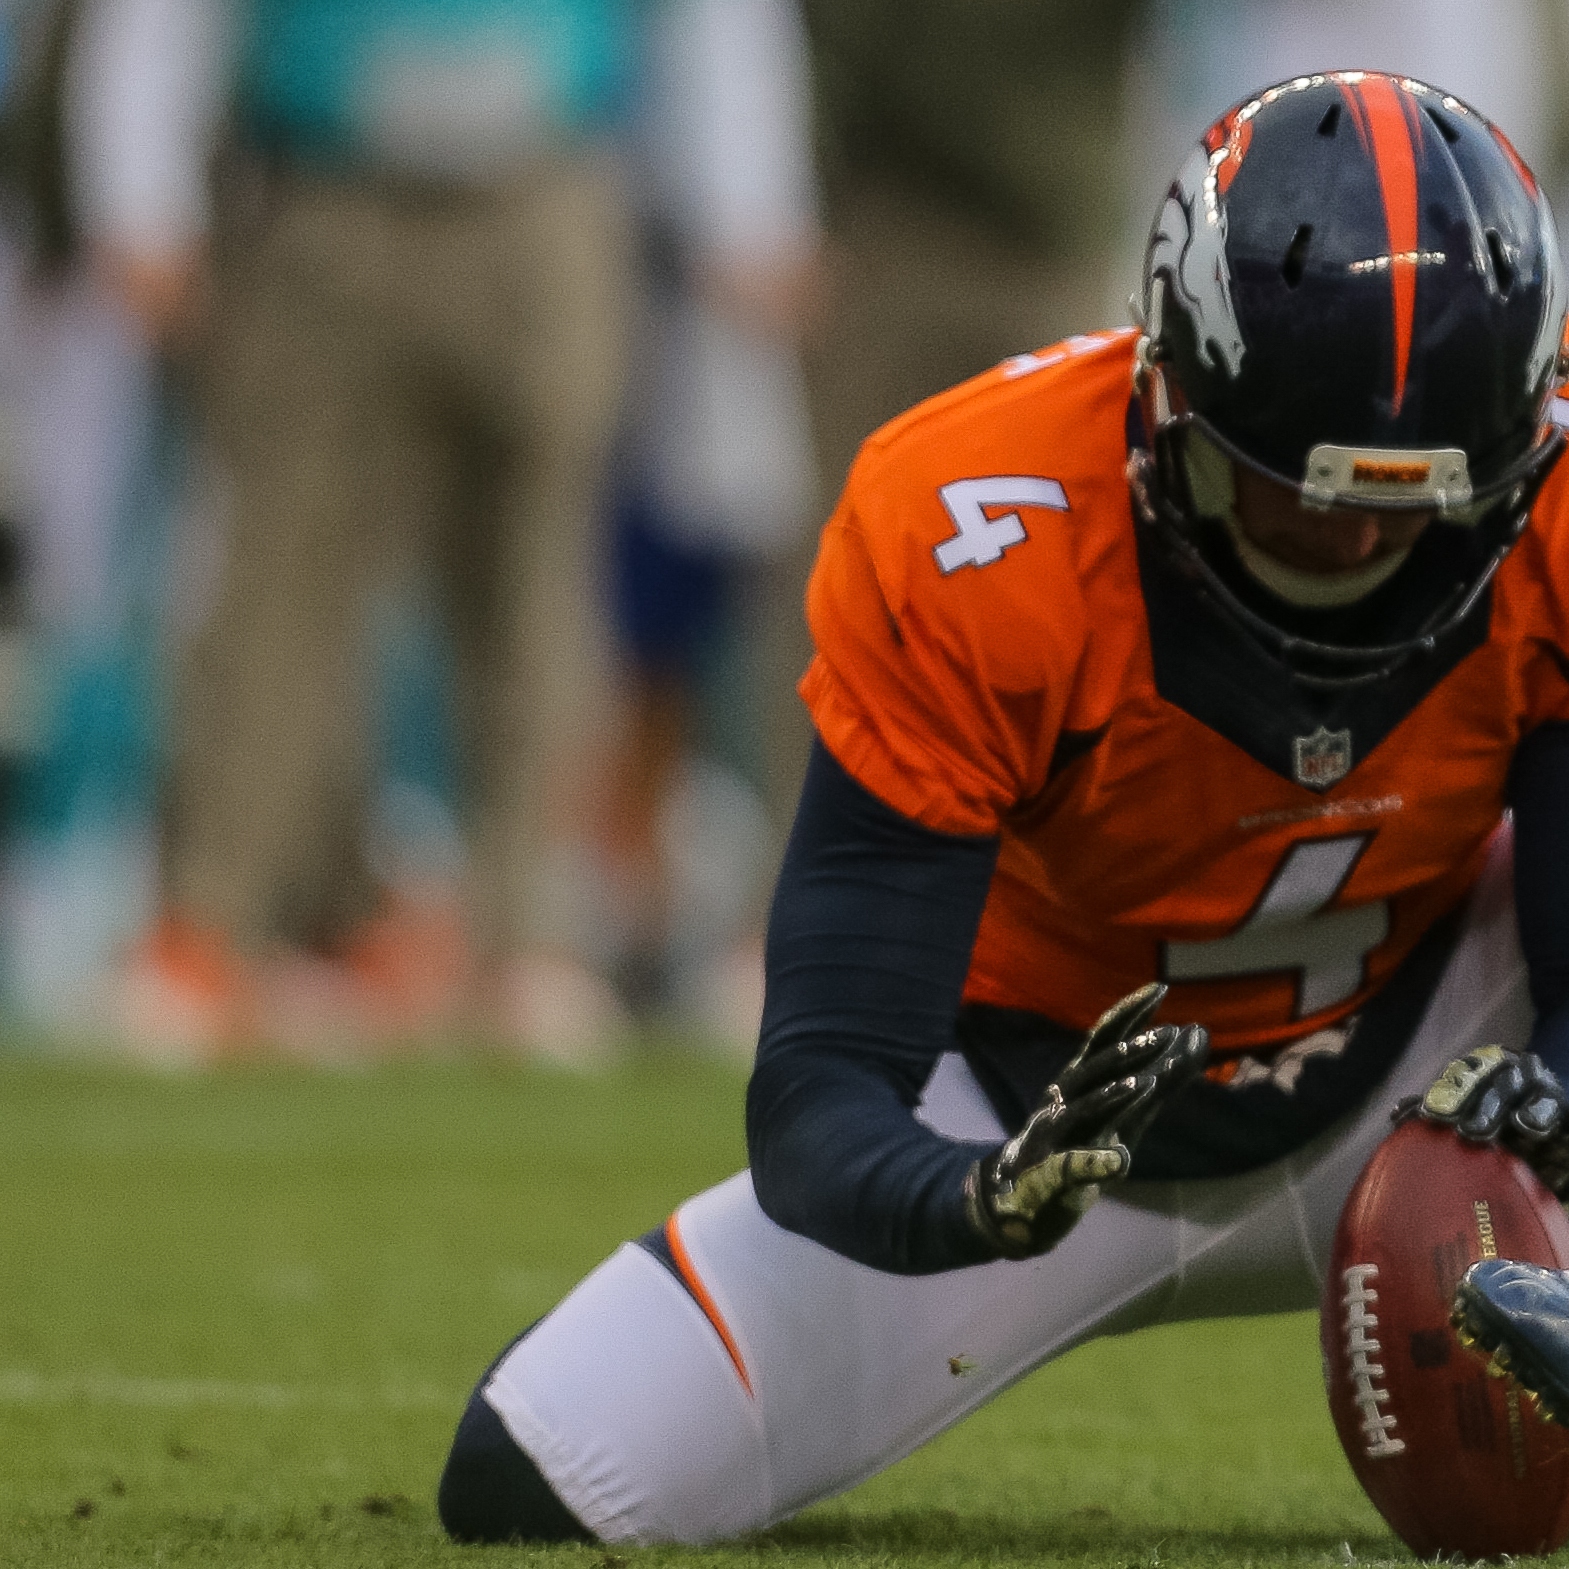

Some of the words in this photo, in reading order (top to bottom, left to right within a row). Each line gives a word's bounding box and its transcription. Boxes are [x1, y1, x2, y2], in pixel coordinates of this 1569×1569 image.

[932, 474, 1069, 575] 4
[1160, 832, 1390, 1016] 4
[1474, 1199, 1496, 1258] EAGUE
